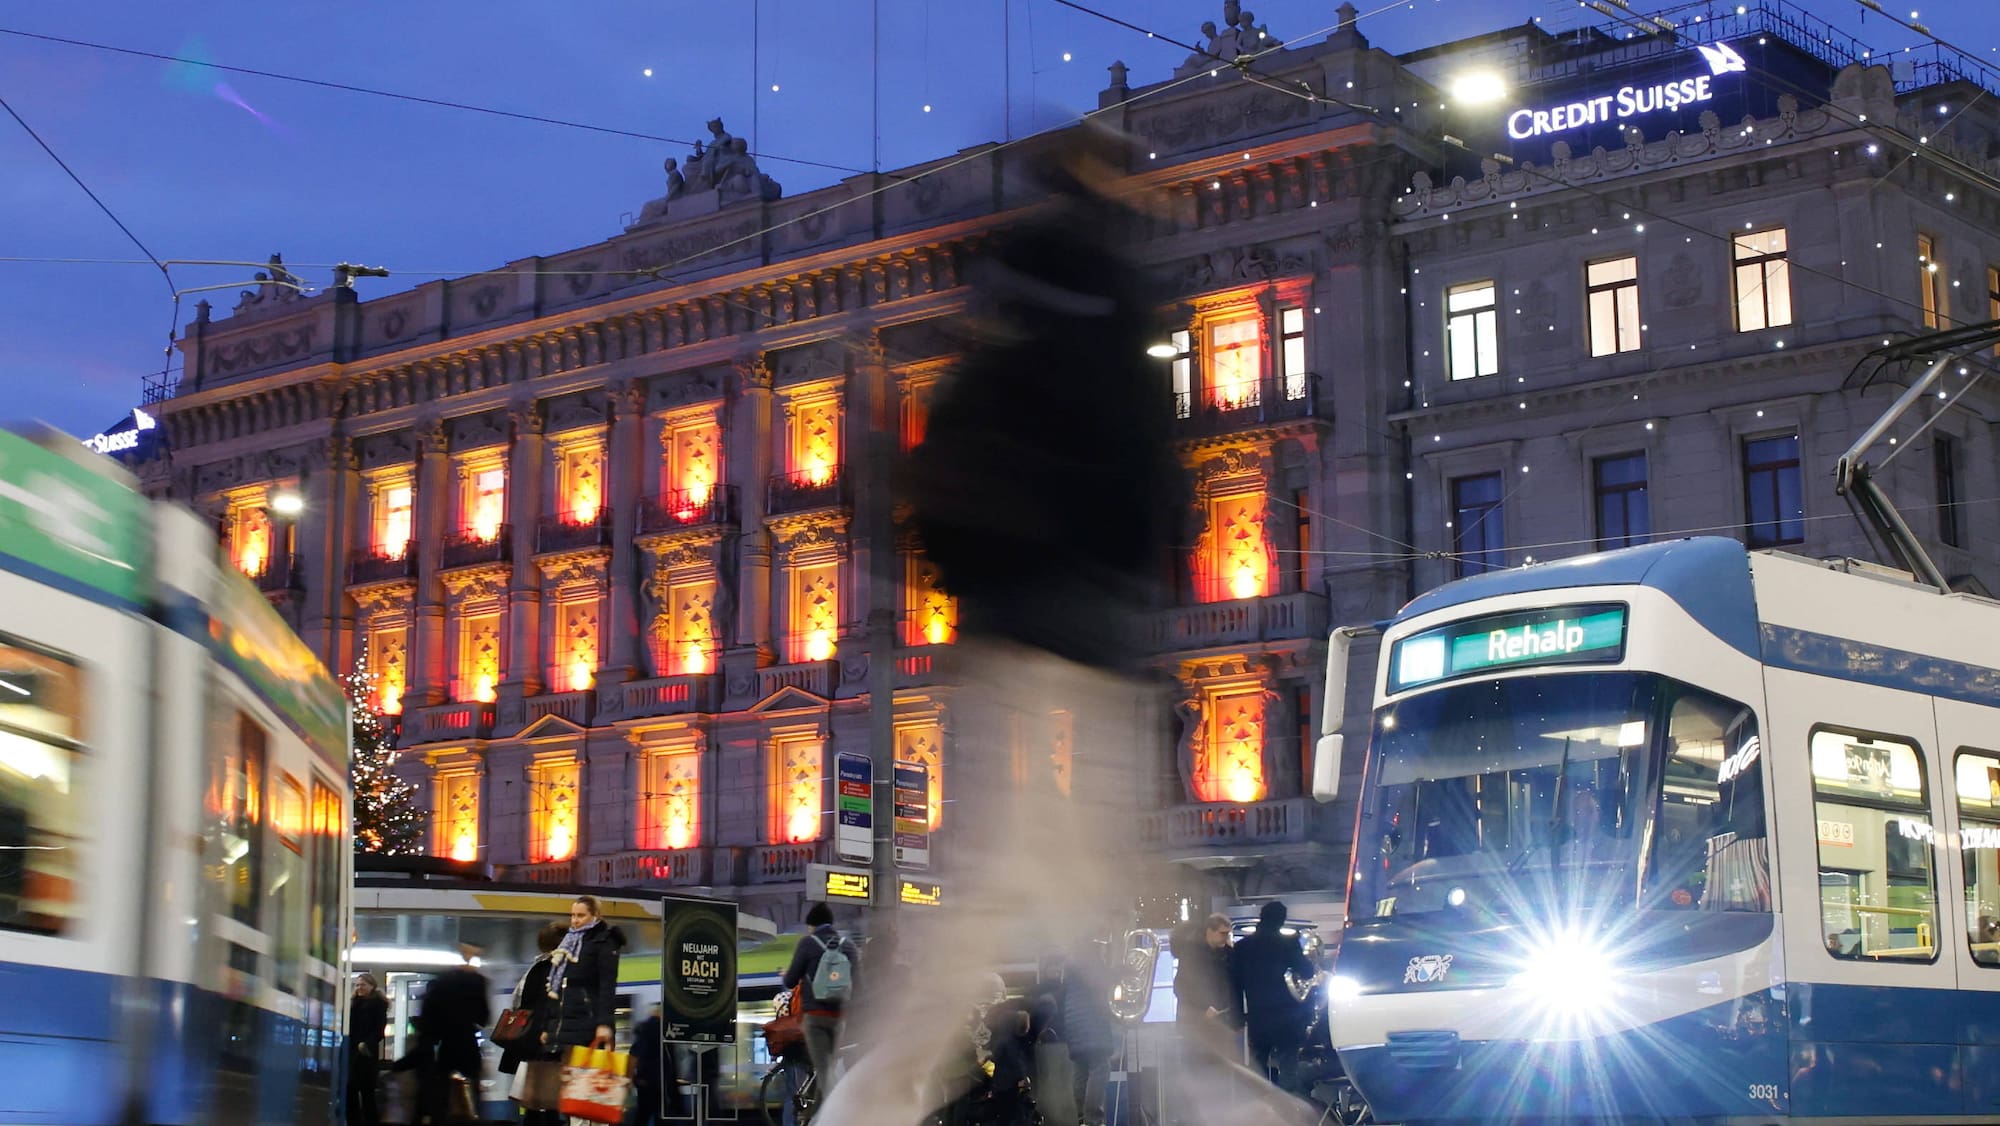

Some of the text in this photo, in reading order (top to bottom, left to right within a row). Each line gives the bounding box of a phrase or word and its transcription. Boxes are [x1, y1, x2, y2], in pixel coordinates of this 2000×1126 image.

[1508, 75, 1713, 139] CREDIT SUISSE
[1488, 619, 1584, 661] Rehalp
[682, 942, 719, 955] NEUJAHR
[682, 959, 720, 978] BACH
[1749, 1084, 1778, 1099] 3031
